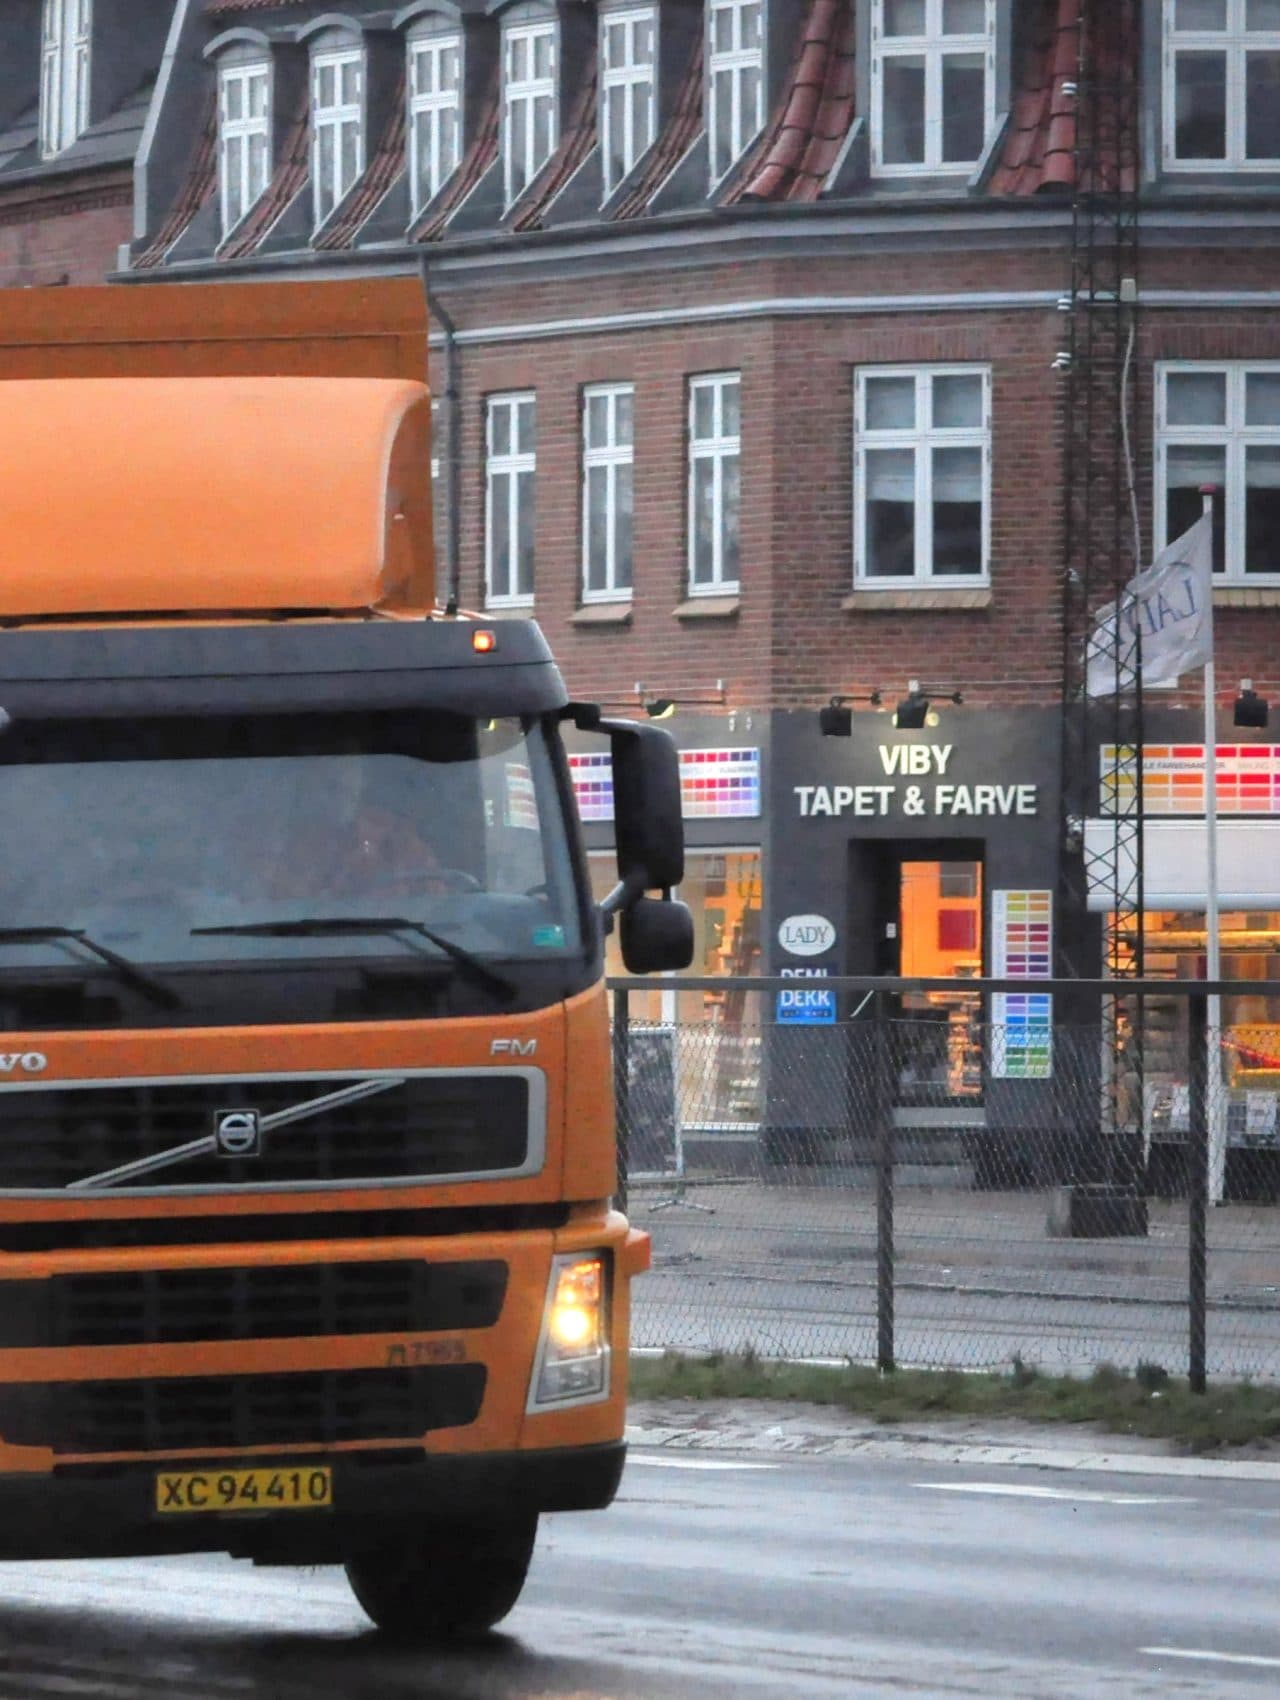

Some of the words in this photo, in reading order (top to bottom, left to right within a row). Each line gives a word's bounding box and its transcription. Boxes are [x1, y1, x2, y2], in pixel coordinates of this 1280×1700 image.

[879, 745, 952, 774] VIBY
[794, 786, 895, 815] TAPET
[903, 786, 925, 815] &
[935, 785, 1037, 815] FARVE
[785, 926, 829, 943] LADY
[781, 990, 830, 1007] DEKK
[490, 1038, 537, 1056] FM
